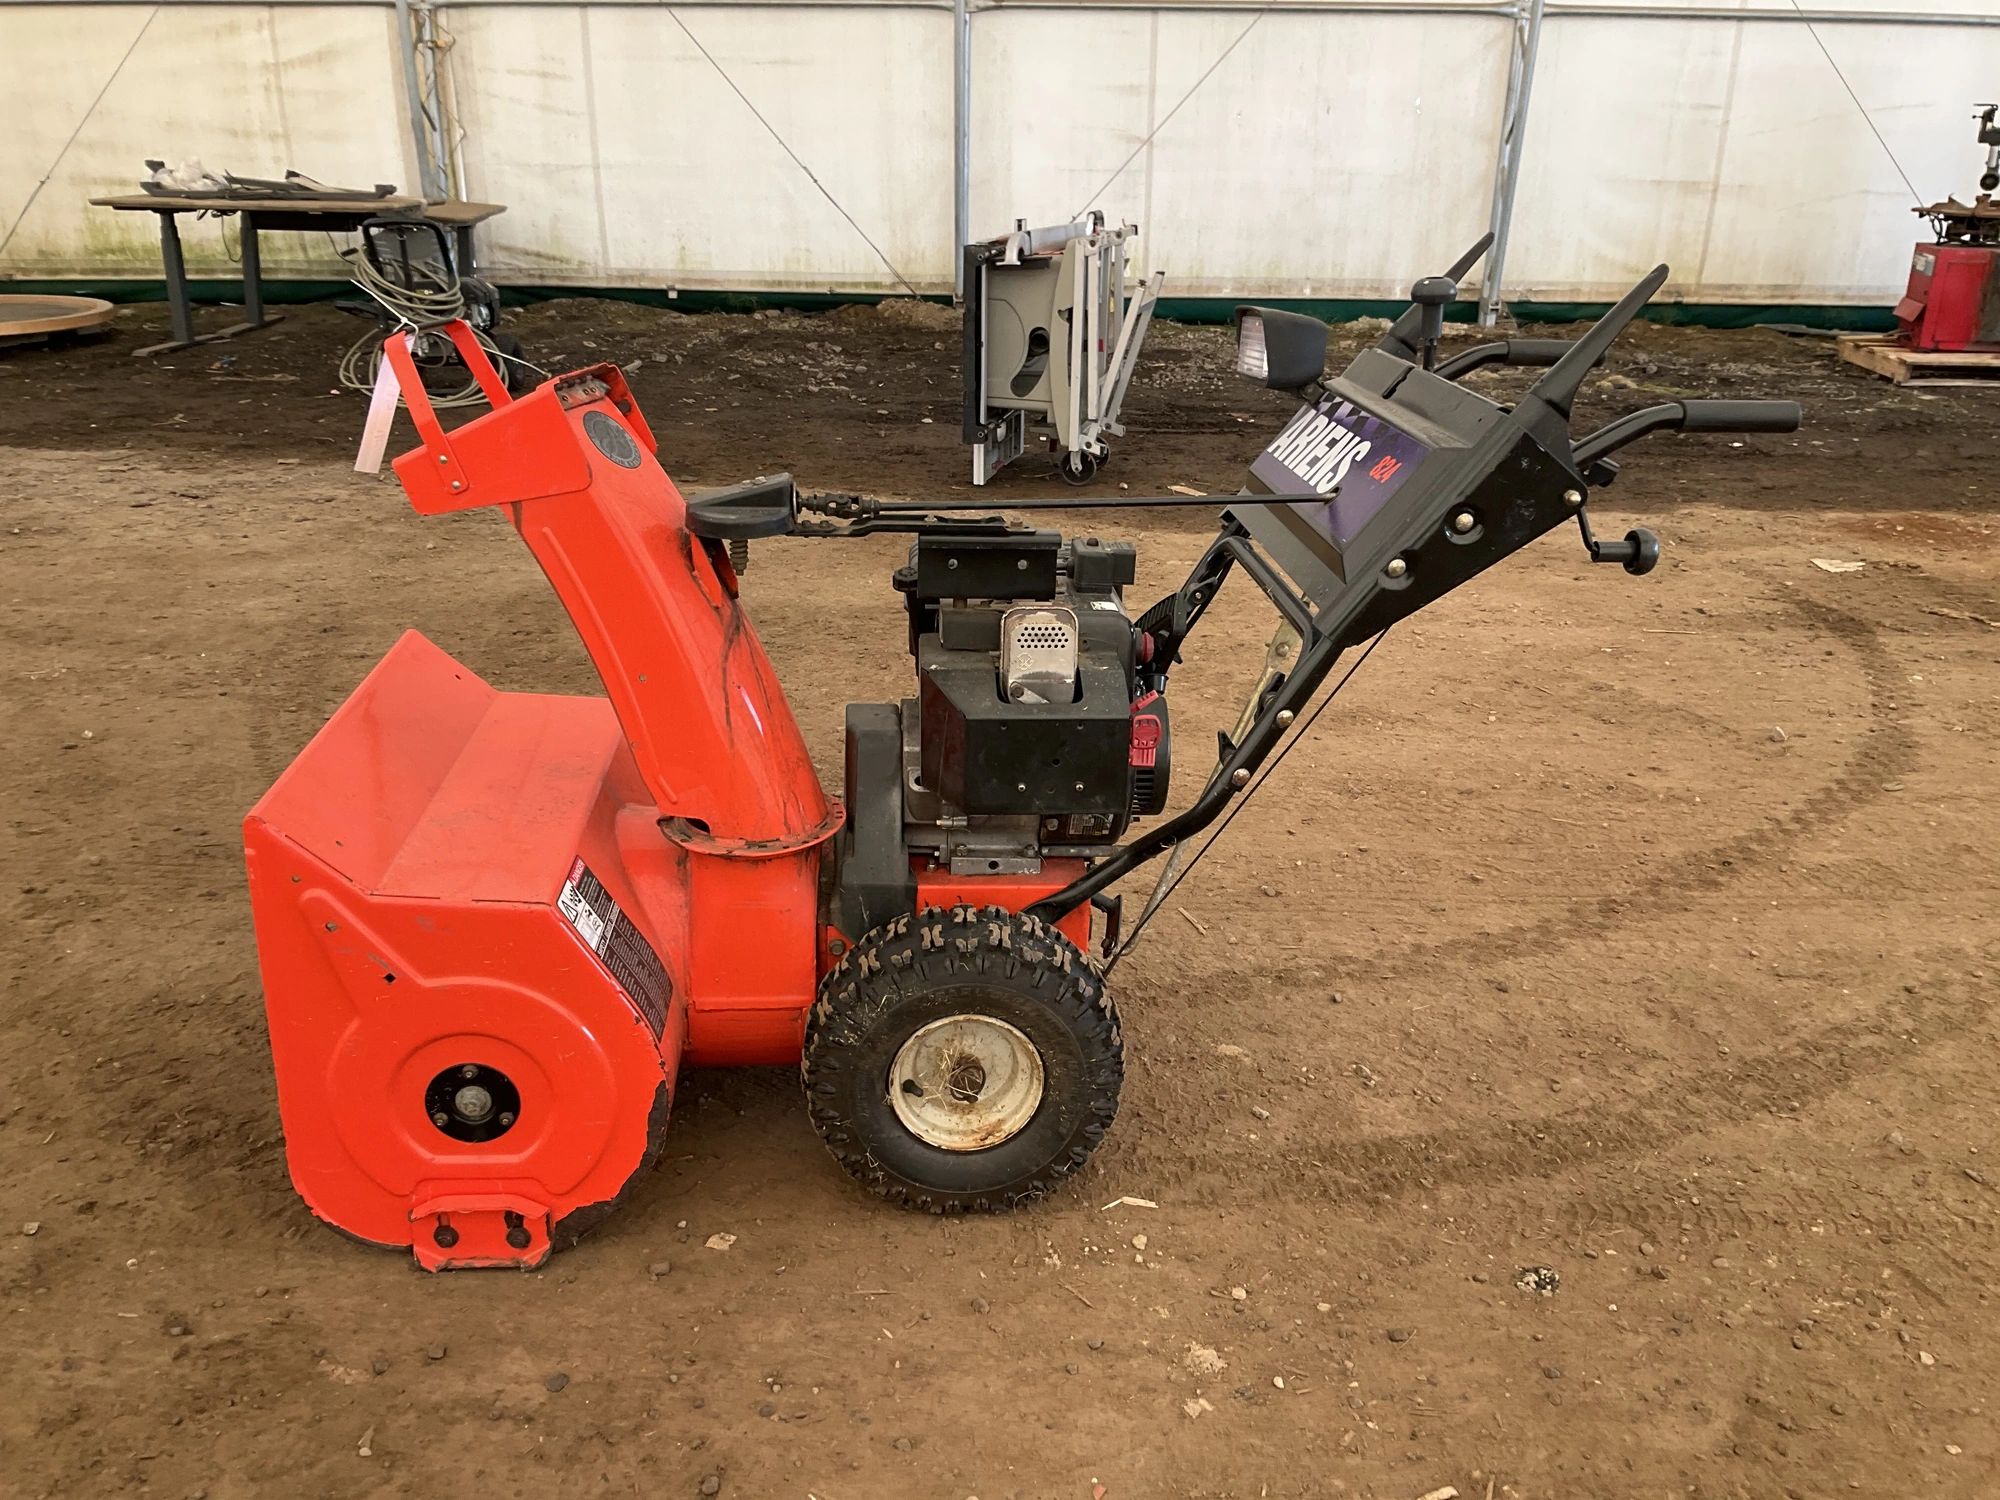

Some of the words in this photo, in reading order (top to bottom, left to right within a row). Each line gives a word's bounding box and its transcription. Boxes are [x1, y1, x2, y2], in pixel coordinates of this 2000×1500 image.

[1267, 409, 1371, 494] ARIENS
[1369, 455, 1402, 484] 824
[572, 859, 585, 882] DANGER
